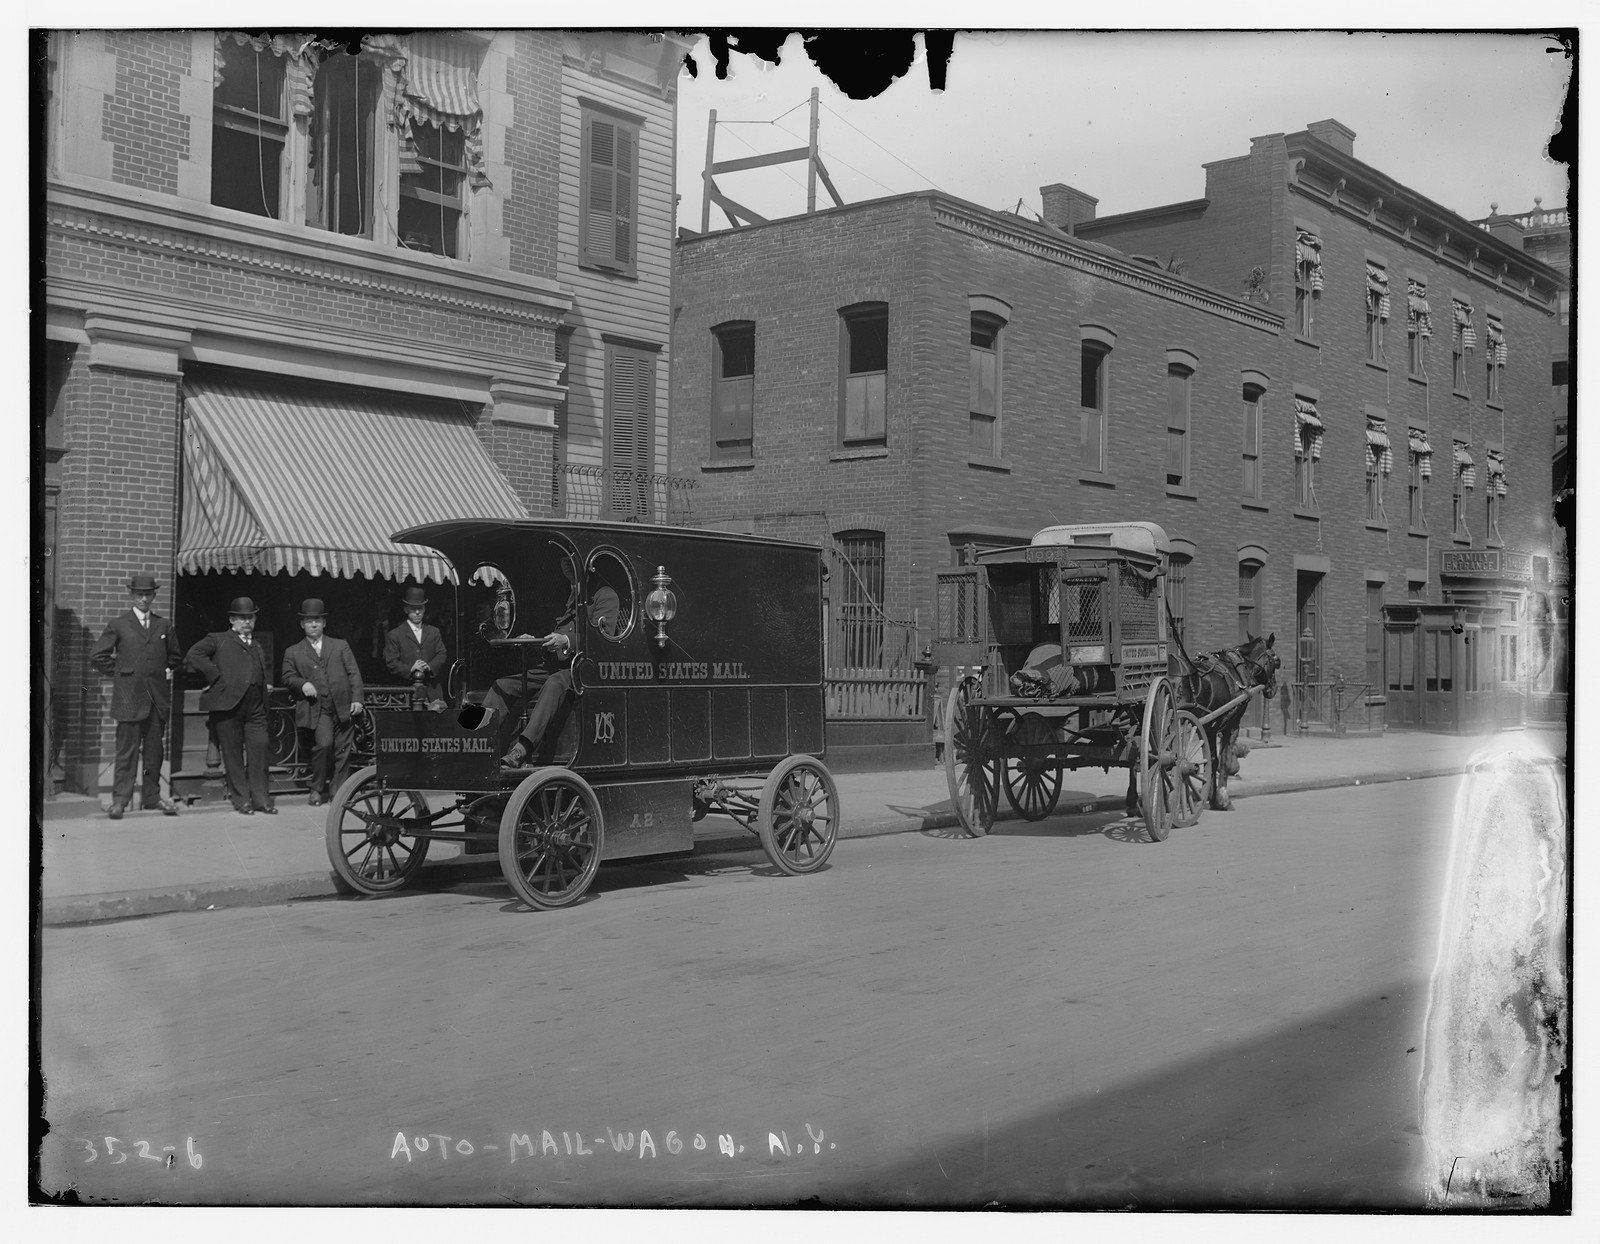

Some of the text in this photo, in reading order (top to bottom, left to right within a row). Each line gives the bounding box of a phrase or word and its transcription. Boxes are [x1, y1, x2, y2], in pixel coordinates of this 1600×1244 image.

[1452, 553, 1489, 562] FAMILY
[1446, 561, 1494, 570] ENTRANCE
[598, 662, 751, 680] UNITED STATES MAIL.
[380, 738, 494, 752] UNITED STATES MAIL.
